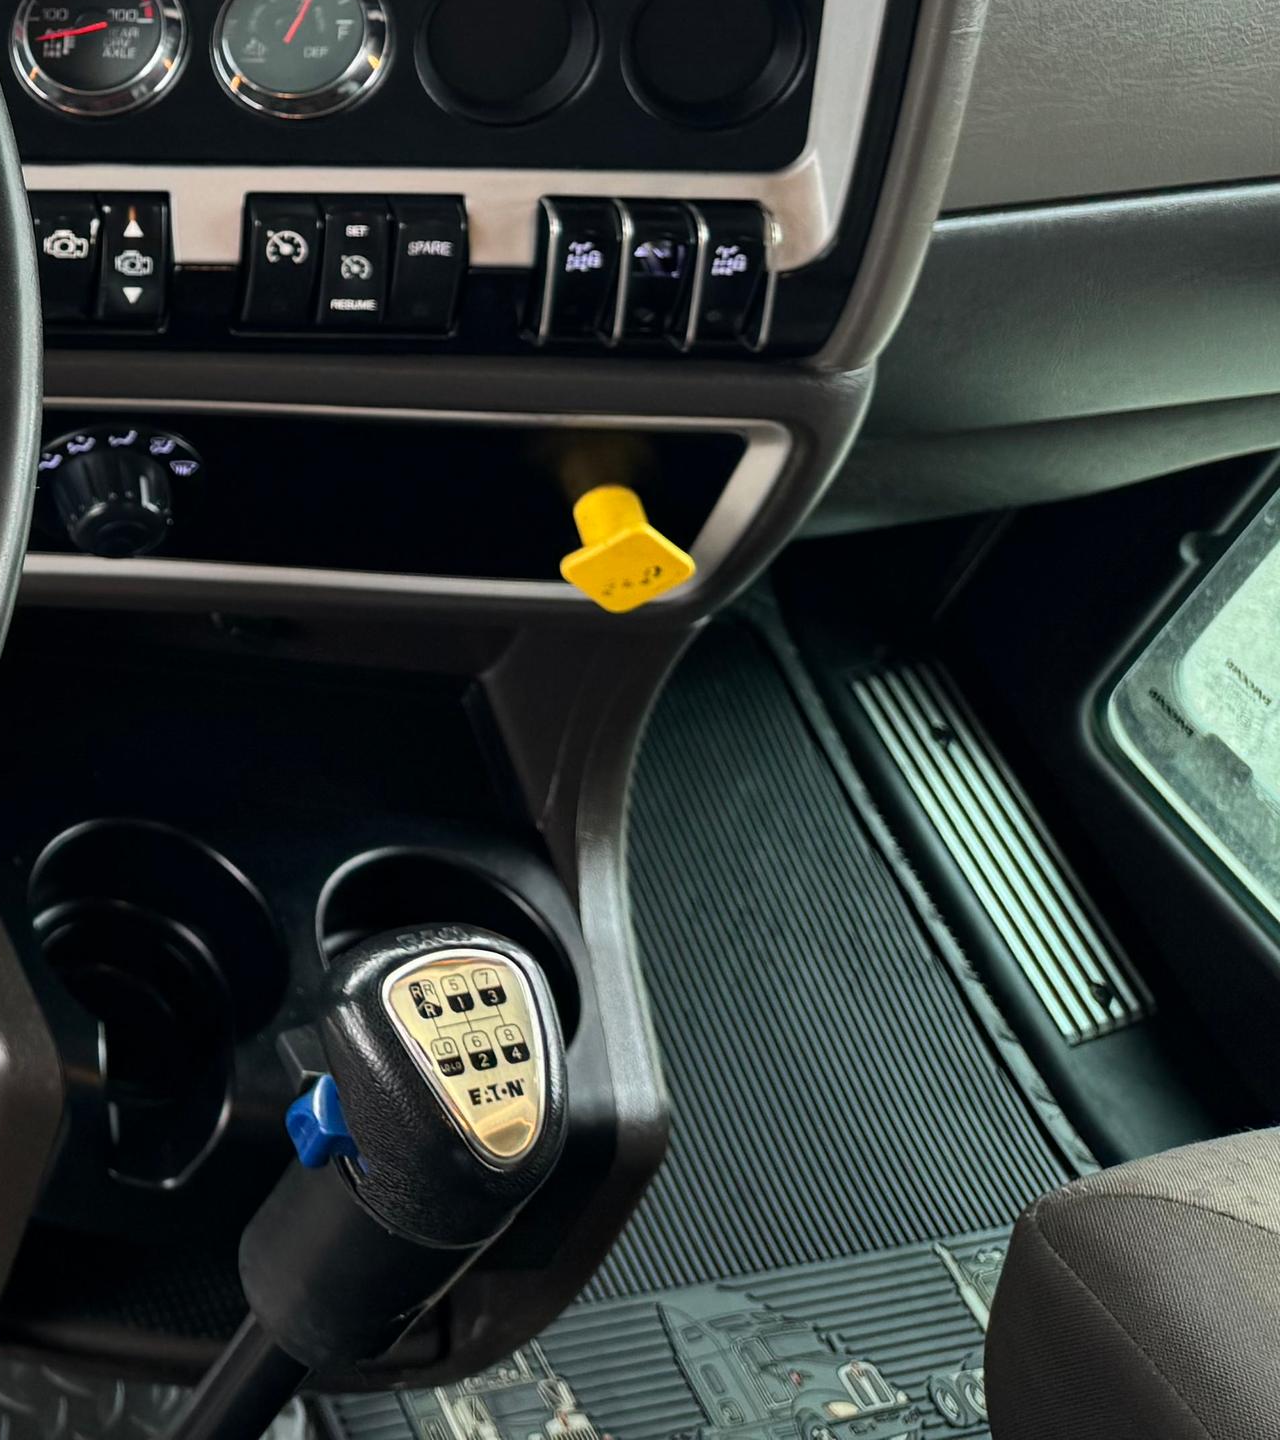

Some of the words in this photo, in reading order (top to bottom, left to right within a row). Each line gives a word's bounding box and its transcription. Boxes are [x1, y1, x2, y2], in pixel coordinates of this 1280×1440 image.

[345, 225, 370, 237] SET
[407, 241, 453, 257] SPARE
[449, 978, 460, 992] 5
[480, 972, 490, 985] 7
[456, 996, 466, 1010] 1
[487, 990, 499, 1003] 3
[424, 1004, 438, 1017] R
[471, 1035, 481, 1048] 6
[503, 1028, 515, 1042] 8
[511, 1046, 523, 1060] 4
[478, 1054, 490, 1068] 2
